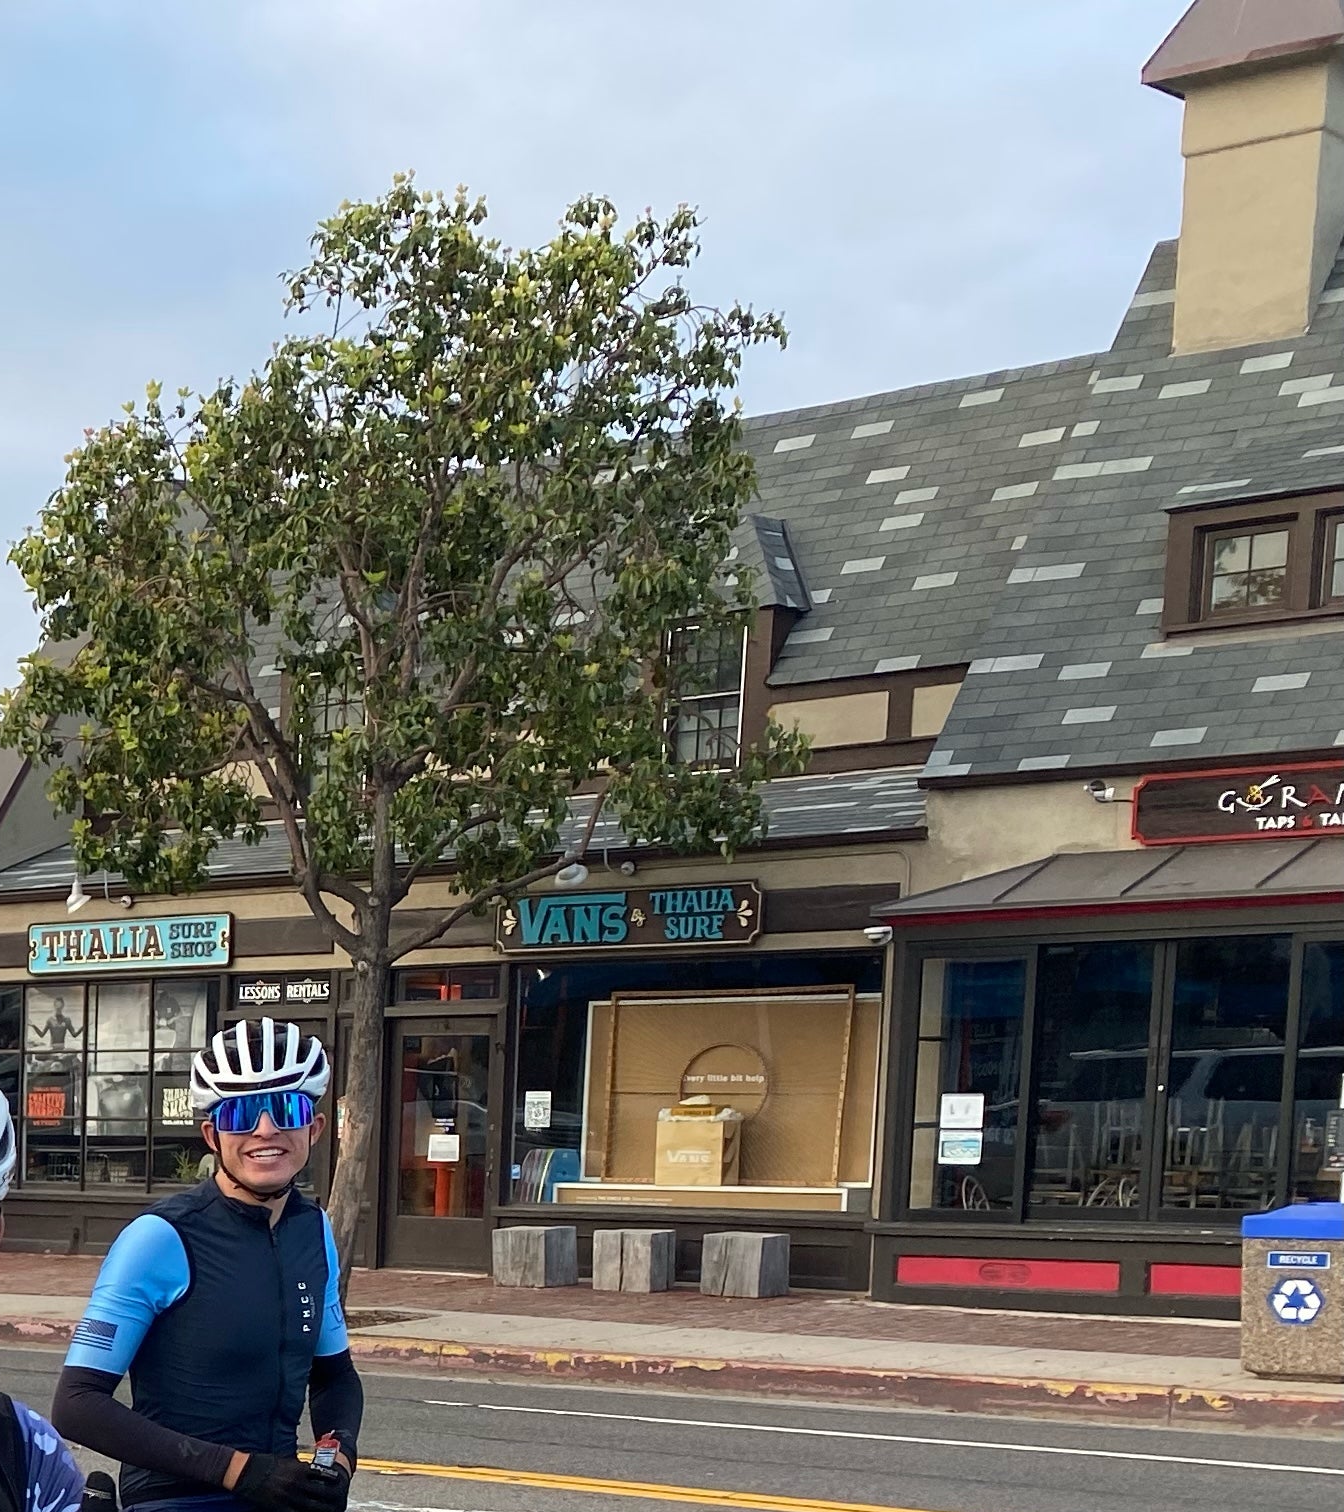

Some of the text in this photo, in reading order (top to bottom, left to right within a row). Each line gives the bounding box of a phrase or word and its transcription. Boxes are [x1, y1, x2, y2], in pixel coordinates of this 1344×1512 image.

[1255, 815, 1296, 830] TAPS
[649, 888, 737, 914] THALIA
[517, 892, 628, 945] VANS
[664, 914, 726, 940] SURF
[168, 921, 217, 940] SURF
[41, 924, 167, 965] THALIA
[170, 941, 217, 959] SHOP
[239, 983, 281, 1002] LESSONS
[286, 981, 330, 999] RENTALS
[684, 1075, 705, 1083] very
[1279, 1256, 1318, 1265] RECYCLE
